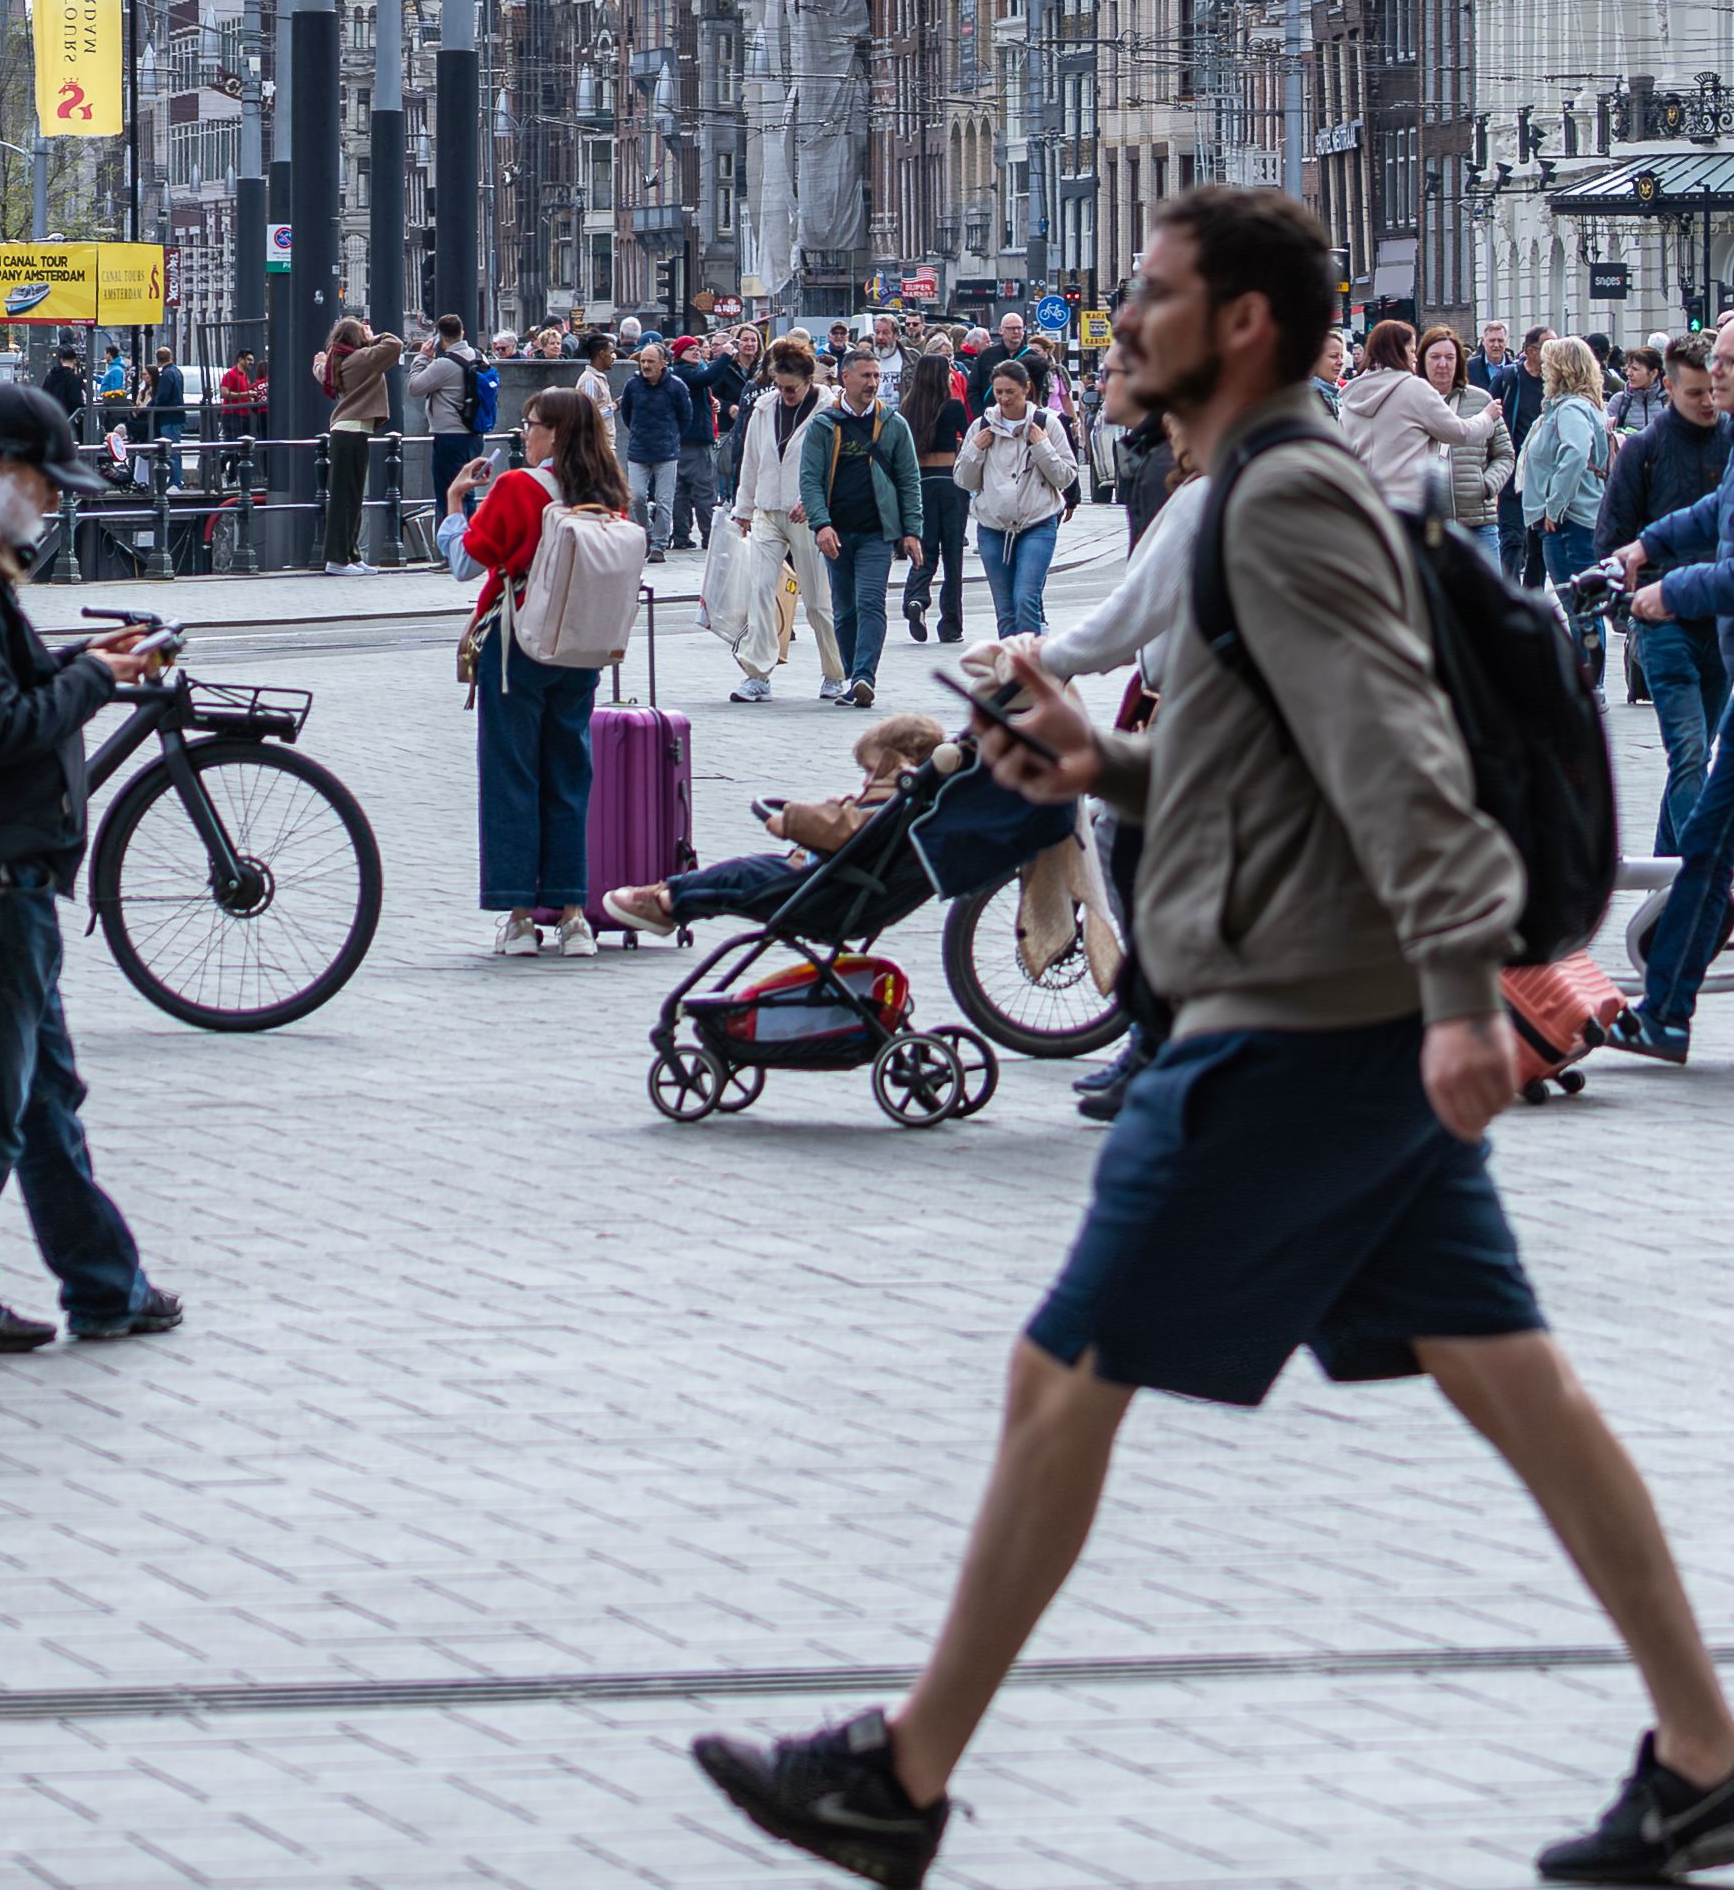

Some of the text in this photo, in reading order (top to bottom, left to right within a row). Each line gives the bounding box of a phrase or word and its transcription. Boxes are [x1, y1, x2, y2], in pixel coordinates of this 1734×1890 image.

[2, 255, 38, 267] CANAL
[41, 255, 68, 267] TOUR
[24, 269, 85, 282] AMSTERDAM
[101, 270, 145, 283] CANAL TOURS
[103, 287, 143, 300] AMSTERDAM
[905, 283, 932, 291] SUPER
